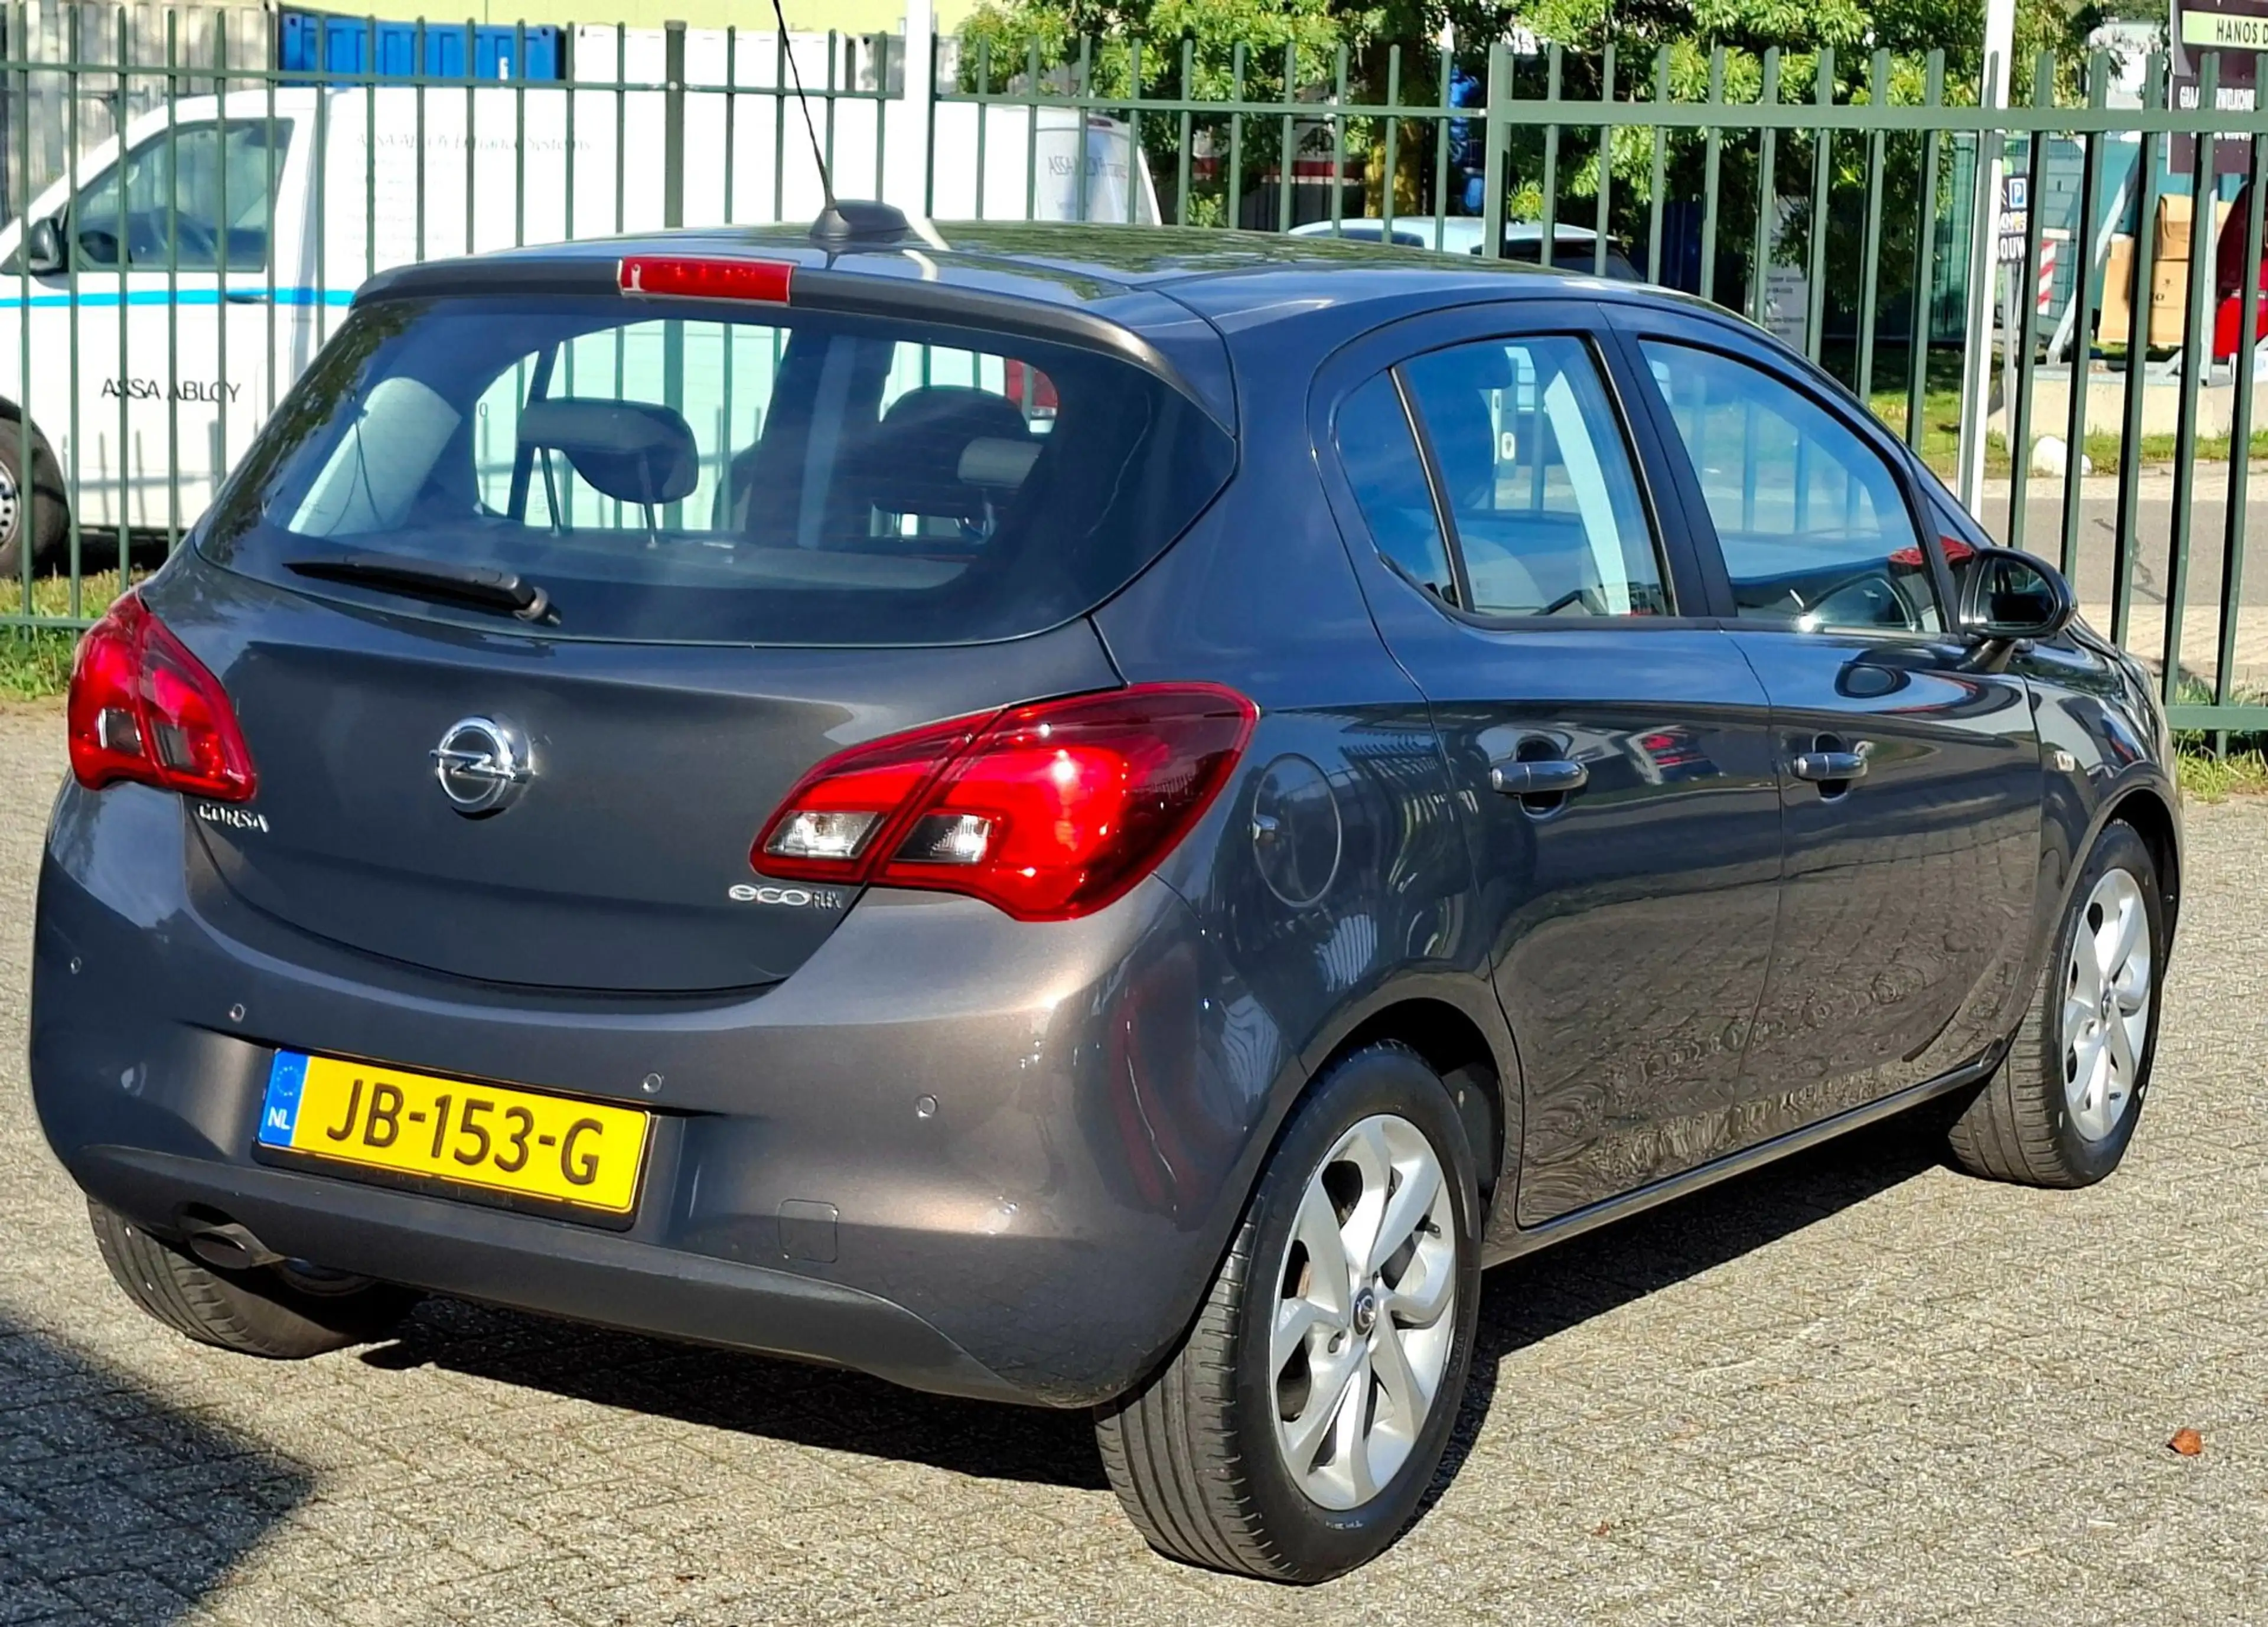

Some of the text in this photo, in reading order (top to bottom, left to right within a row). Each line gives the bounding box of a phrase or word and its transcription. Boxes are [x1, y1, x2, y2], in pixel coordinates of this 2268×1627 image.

[2217, 18, 2257, 44] HANOS
[199, 803, 269, 833] CORSA
[268, 1106, 291, 1130] NL
[326, 1078, 604, 1185] JB-153-G
